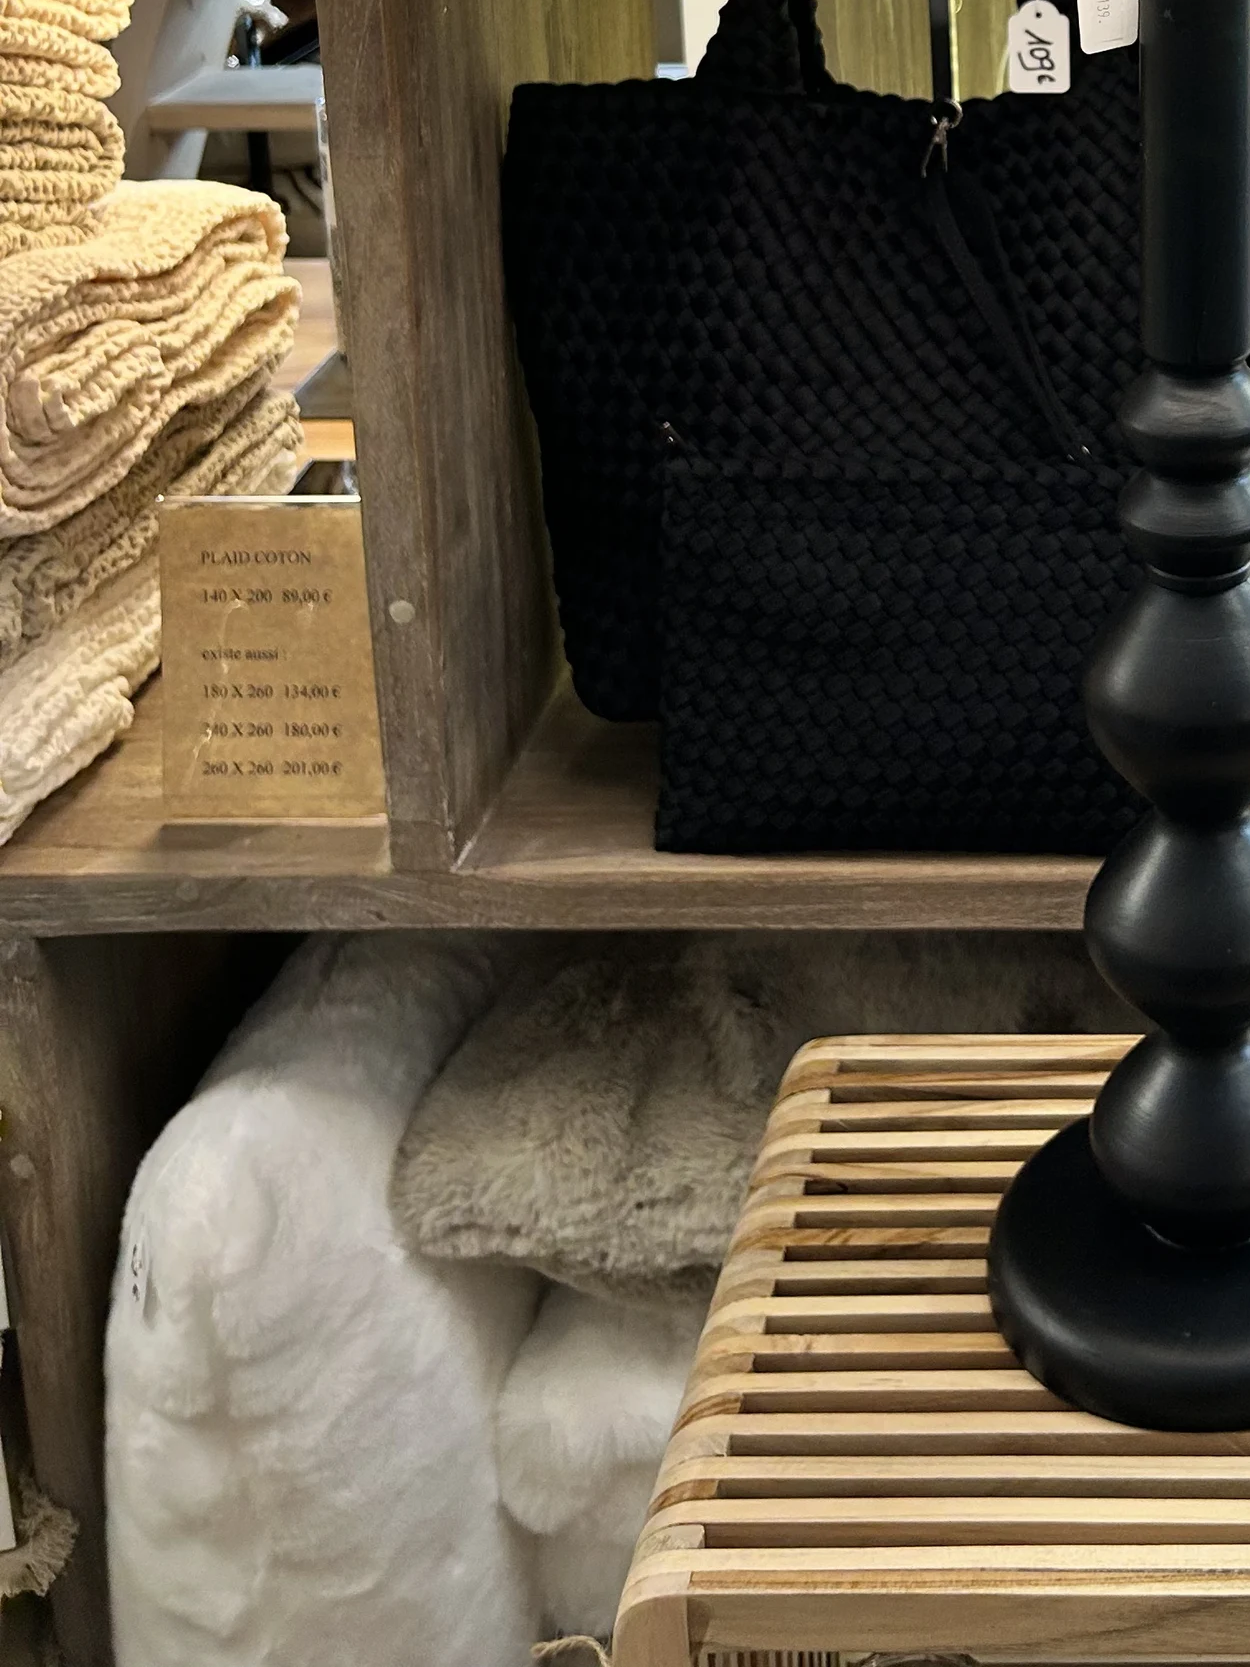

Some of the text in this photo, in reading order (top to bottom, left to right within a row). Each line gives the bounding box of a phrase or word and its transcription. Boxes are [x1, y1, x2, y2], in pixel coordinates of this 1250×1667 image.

[201, 549, 311, 566] PLAID COTON
[202, 589, 228, 603] 140
[247, 589, 273, 604] 200
[281, 589, 320, 606] 89,00
[322, 589, 333, 603] €
[202, 649, 242, 662] existe
[245, 646, 279, 662] aussi
[203, 684, 342, 701] 180 X 260 134,00 €
[231, 722, 244, 737] X
[247, 721, 273, 737] 260
[282, 721, 330, 738] 180,00
[331, 722, 343, 738] €
[202, 760, 343, 777] 260 X 260 201,00 €
